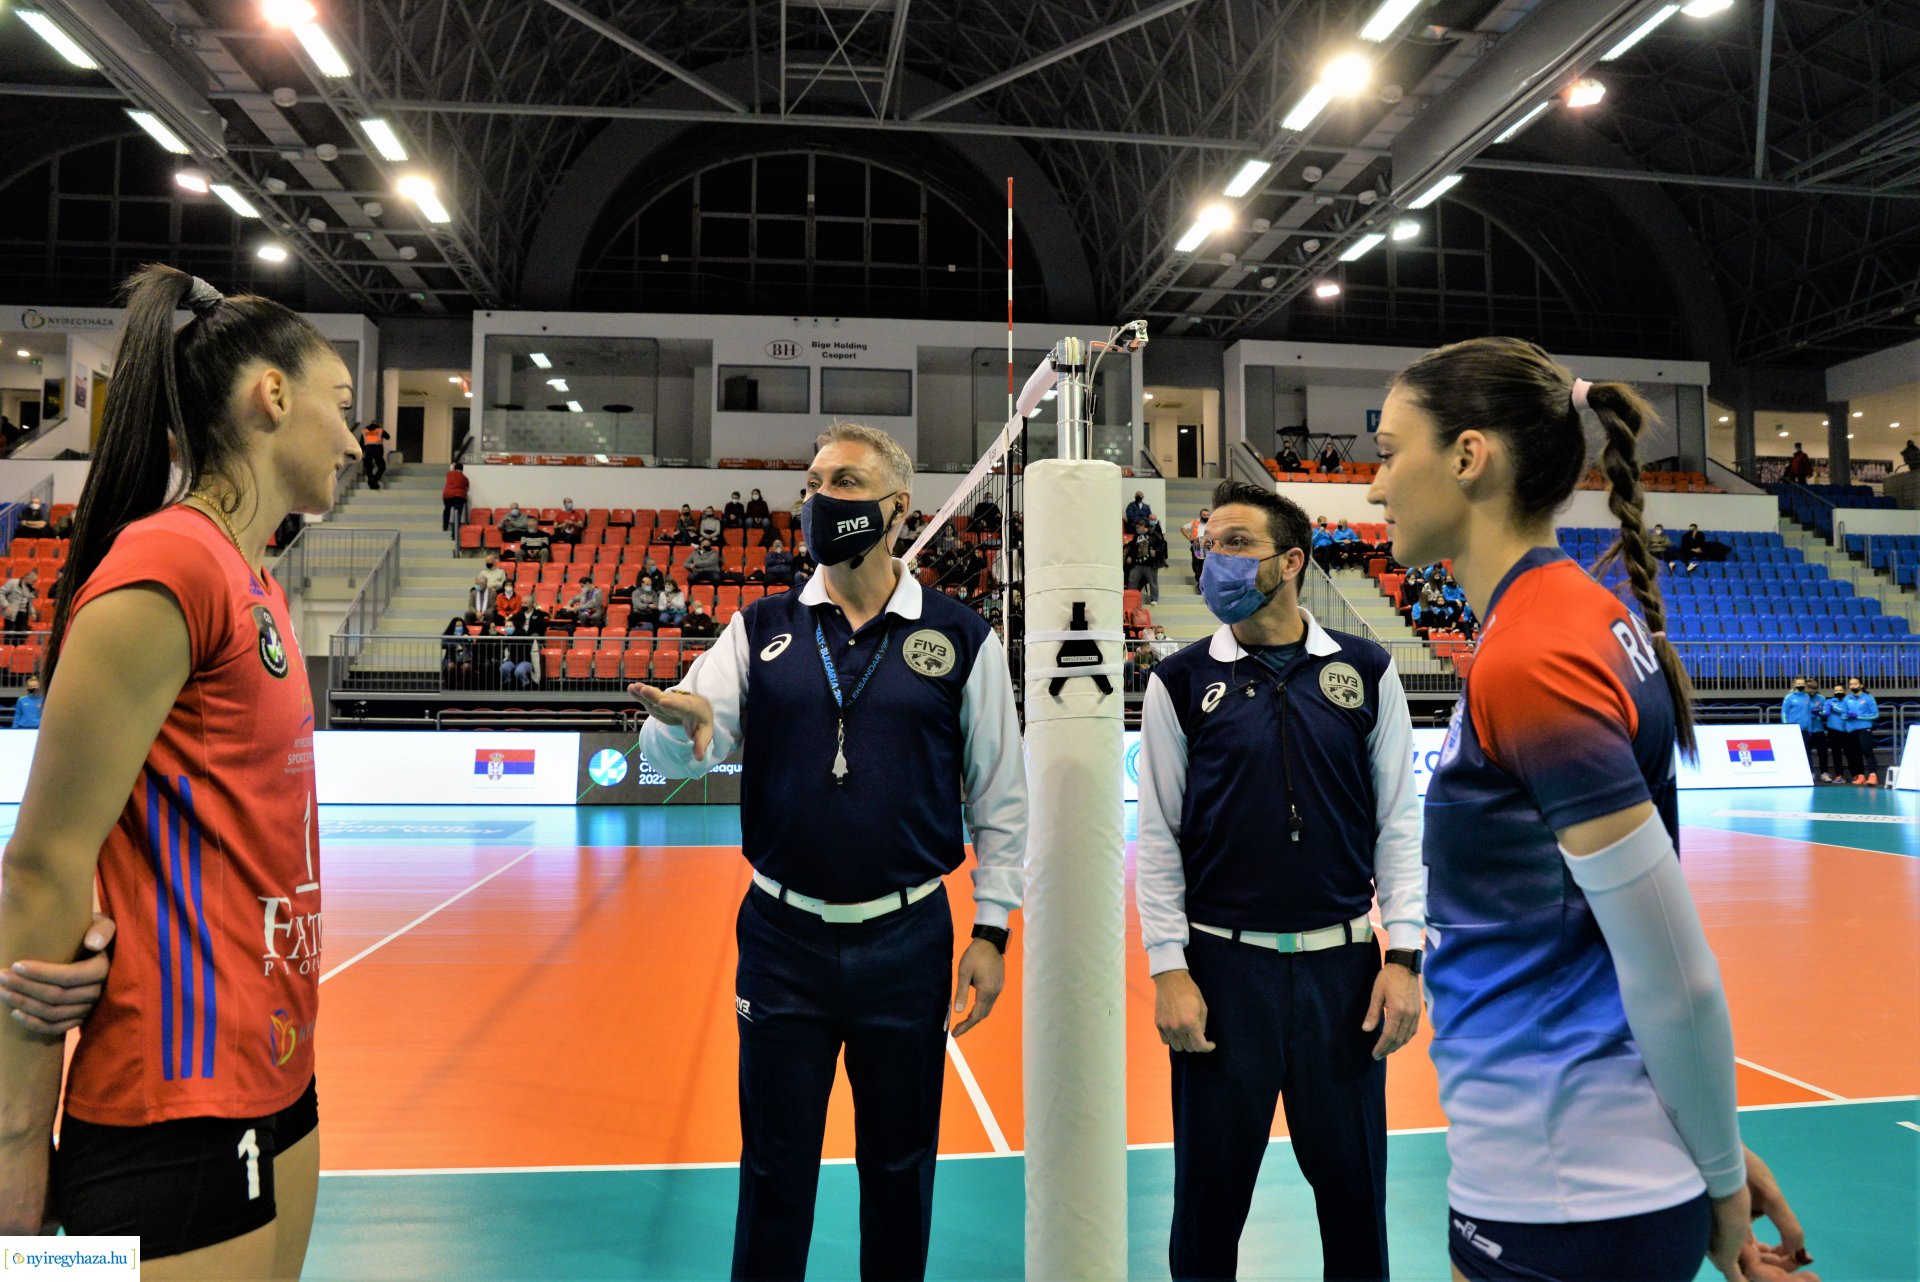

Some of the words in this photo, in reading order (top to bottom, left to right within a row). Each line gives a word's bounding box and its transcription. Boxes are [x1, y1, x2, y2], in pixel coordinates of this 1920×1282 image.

[773, 343, 796, 356] BH
[811, 341, 831, 350] Bige
[833, 342, 868, 351] Holding
[822, 352, 857, 360] Csoport
[836, 516, 870, 534] FIVB
[913, 639, 947, 657] FIVB
[1328, 672, 1359, 688] FIVB
[638, 774, 666, 784] 2022
[237, 1128, 260, 1200] 1
